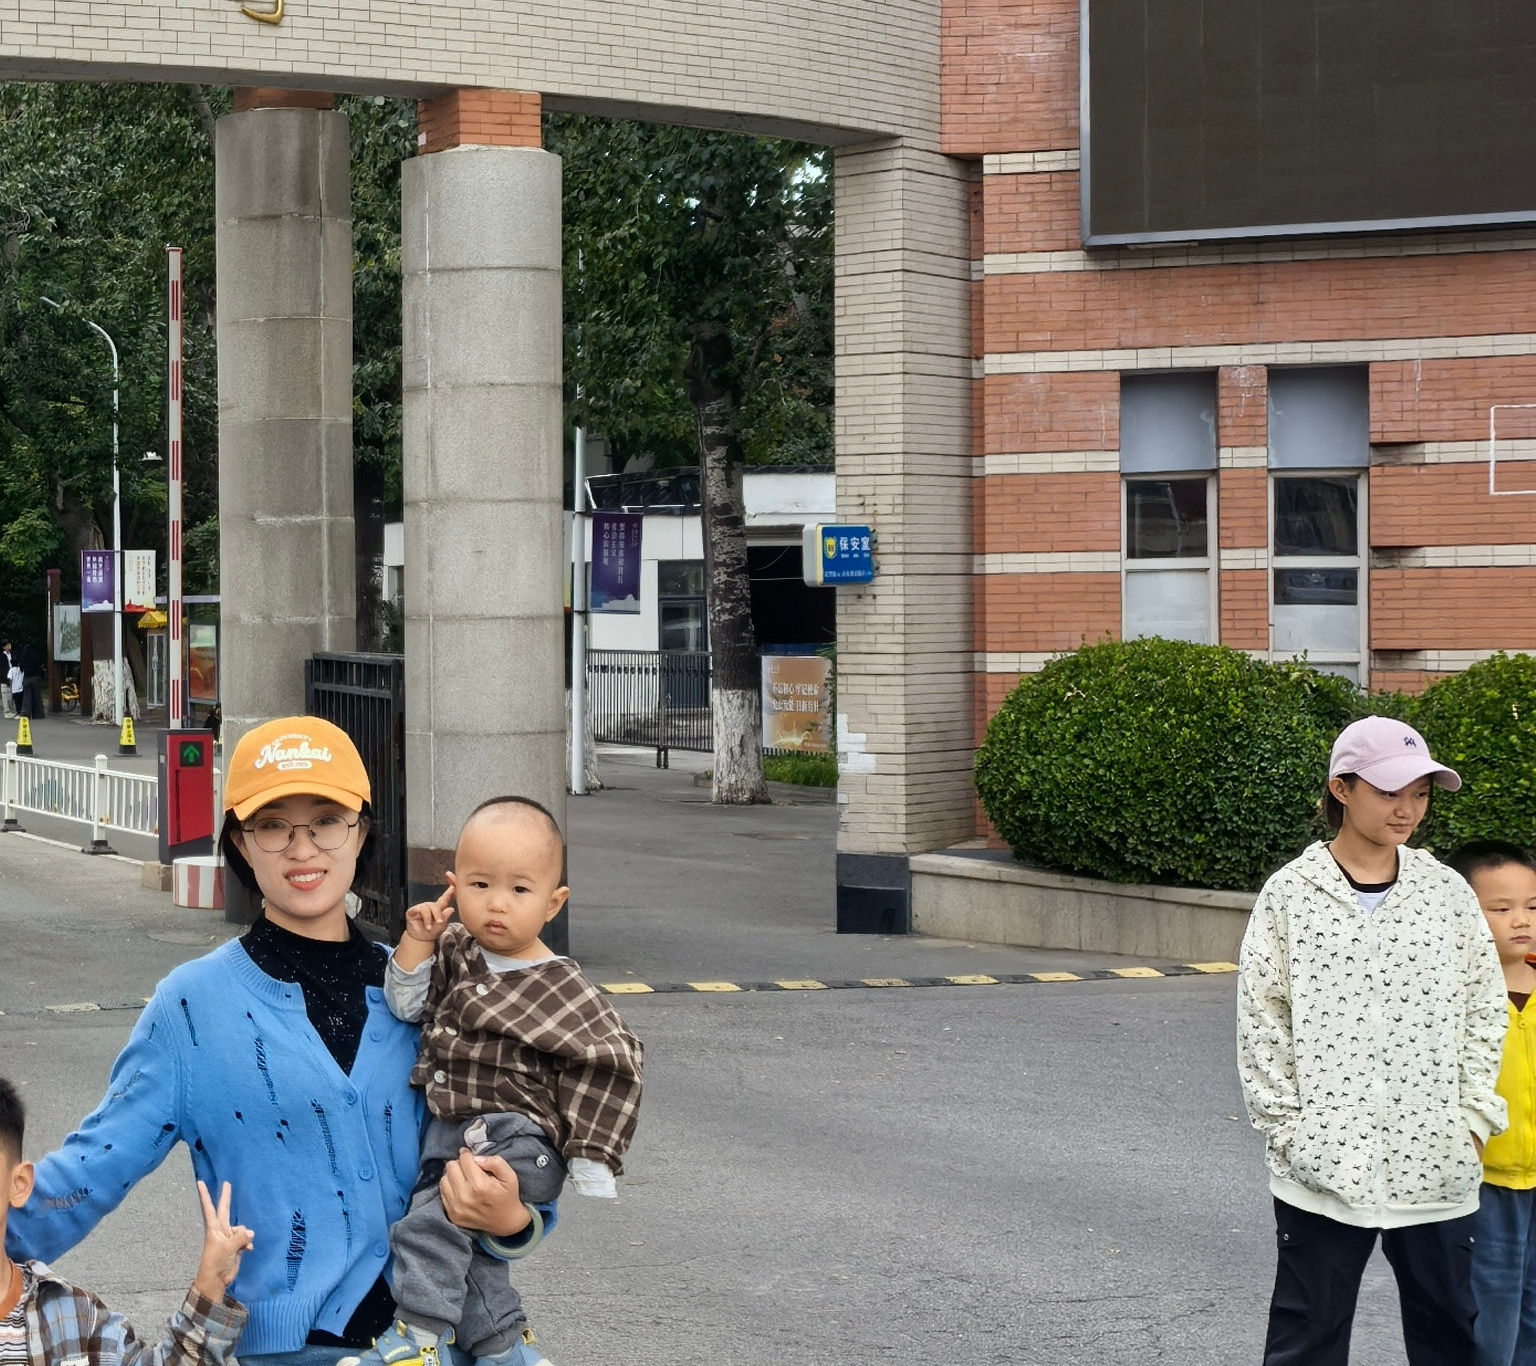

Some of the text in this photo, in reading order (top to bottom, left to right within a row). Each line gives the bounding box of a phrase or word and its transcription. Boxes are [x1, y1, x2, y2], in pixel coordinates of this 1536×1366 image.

[840, 536, 871, 551] 保安室
[254, 741, 333, 769] Nankai
